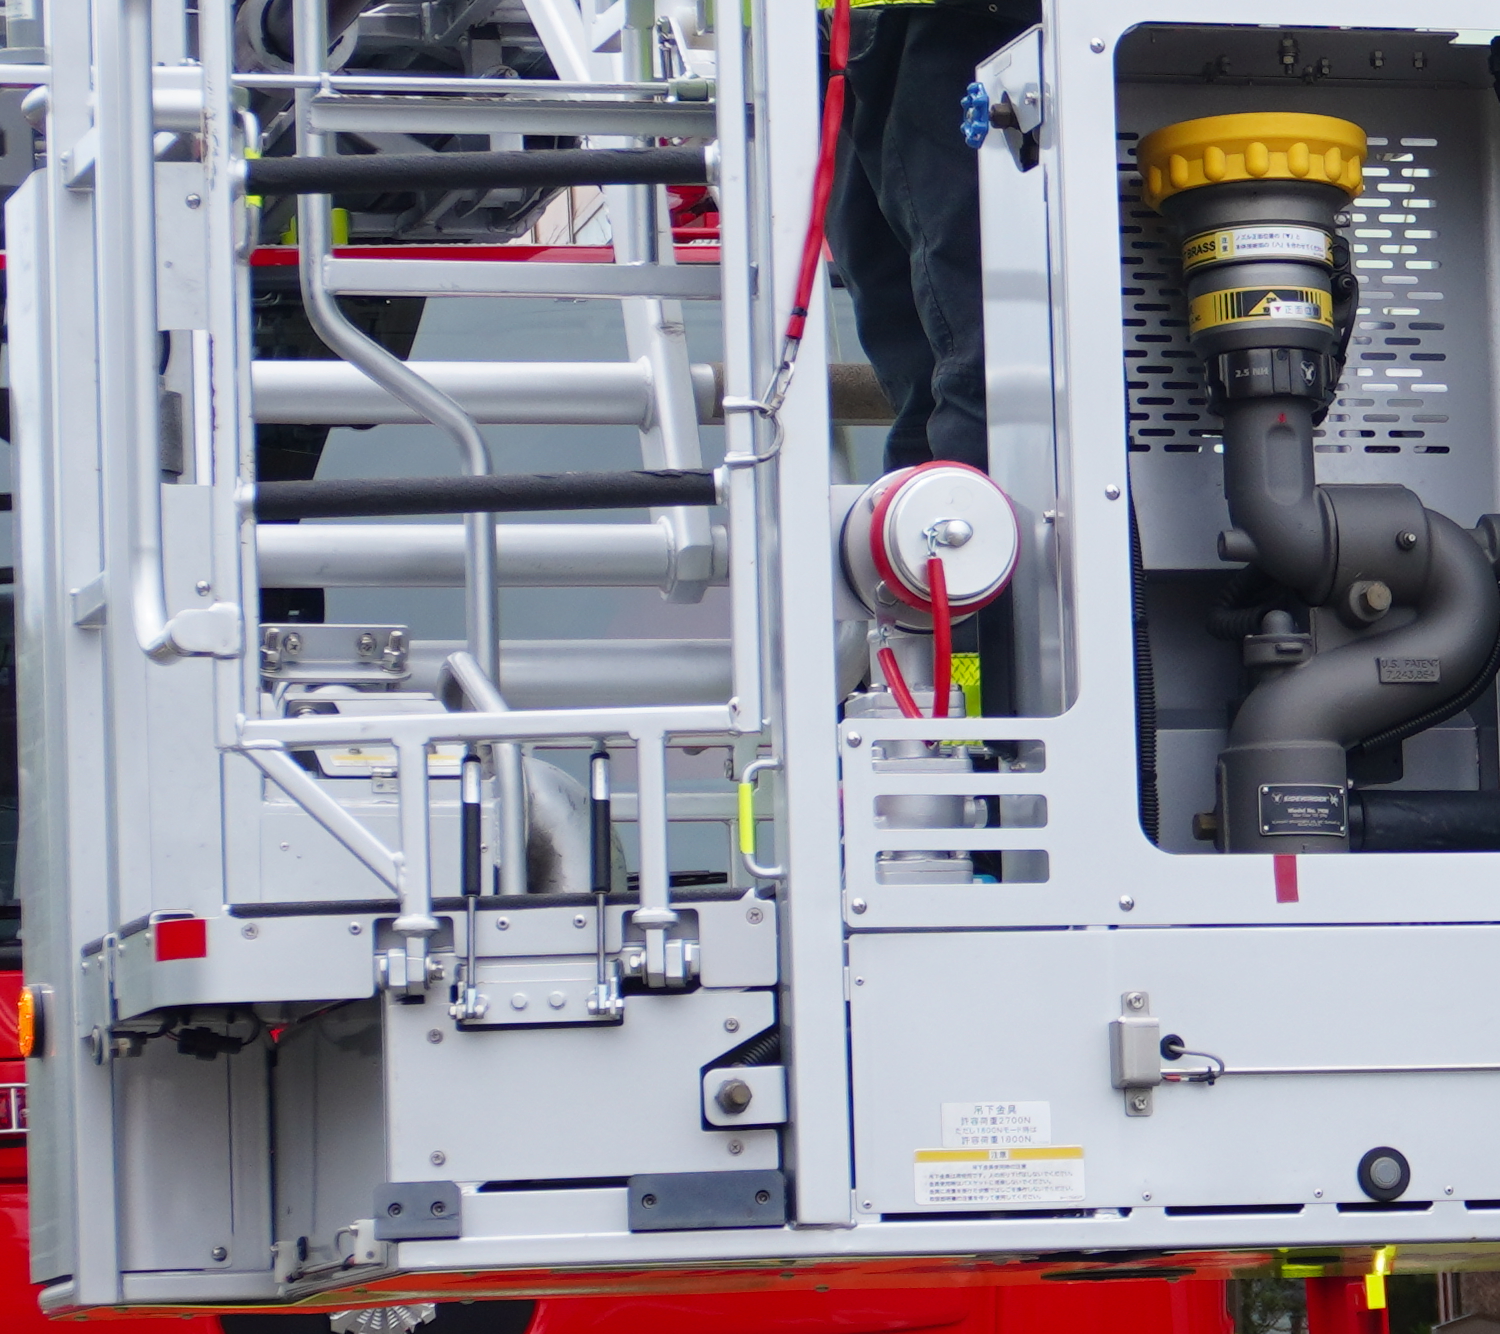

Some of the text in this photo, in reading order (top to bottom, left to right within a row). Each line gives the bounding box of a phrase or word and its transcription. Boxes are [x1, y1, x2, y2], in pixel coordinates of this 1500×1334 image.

[974, 1104, 1017, 1115] 吊下金具
[961, 1116, 1031, 1126] 許容荷重2700N
[961, 1136, 1032, 1146] 許容荷重1800N
[990, 1150, 1007, 1159] 注意
